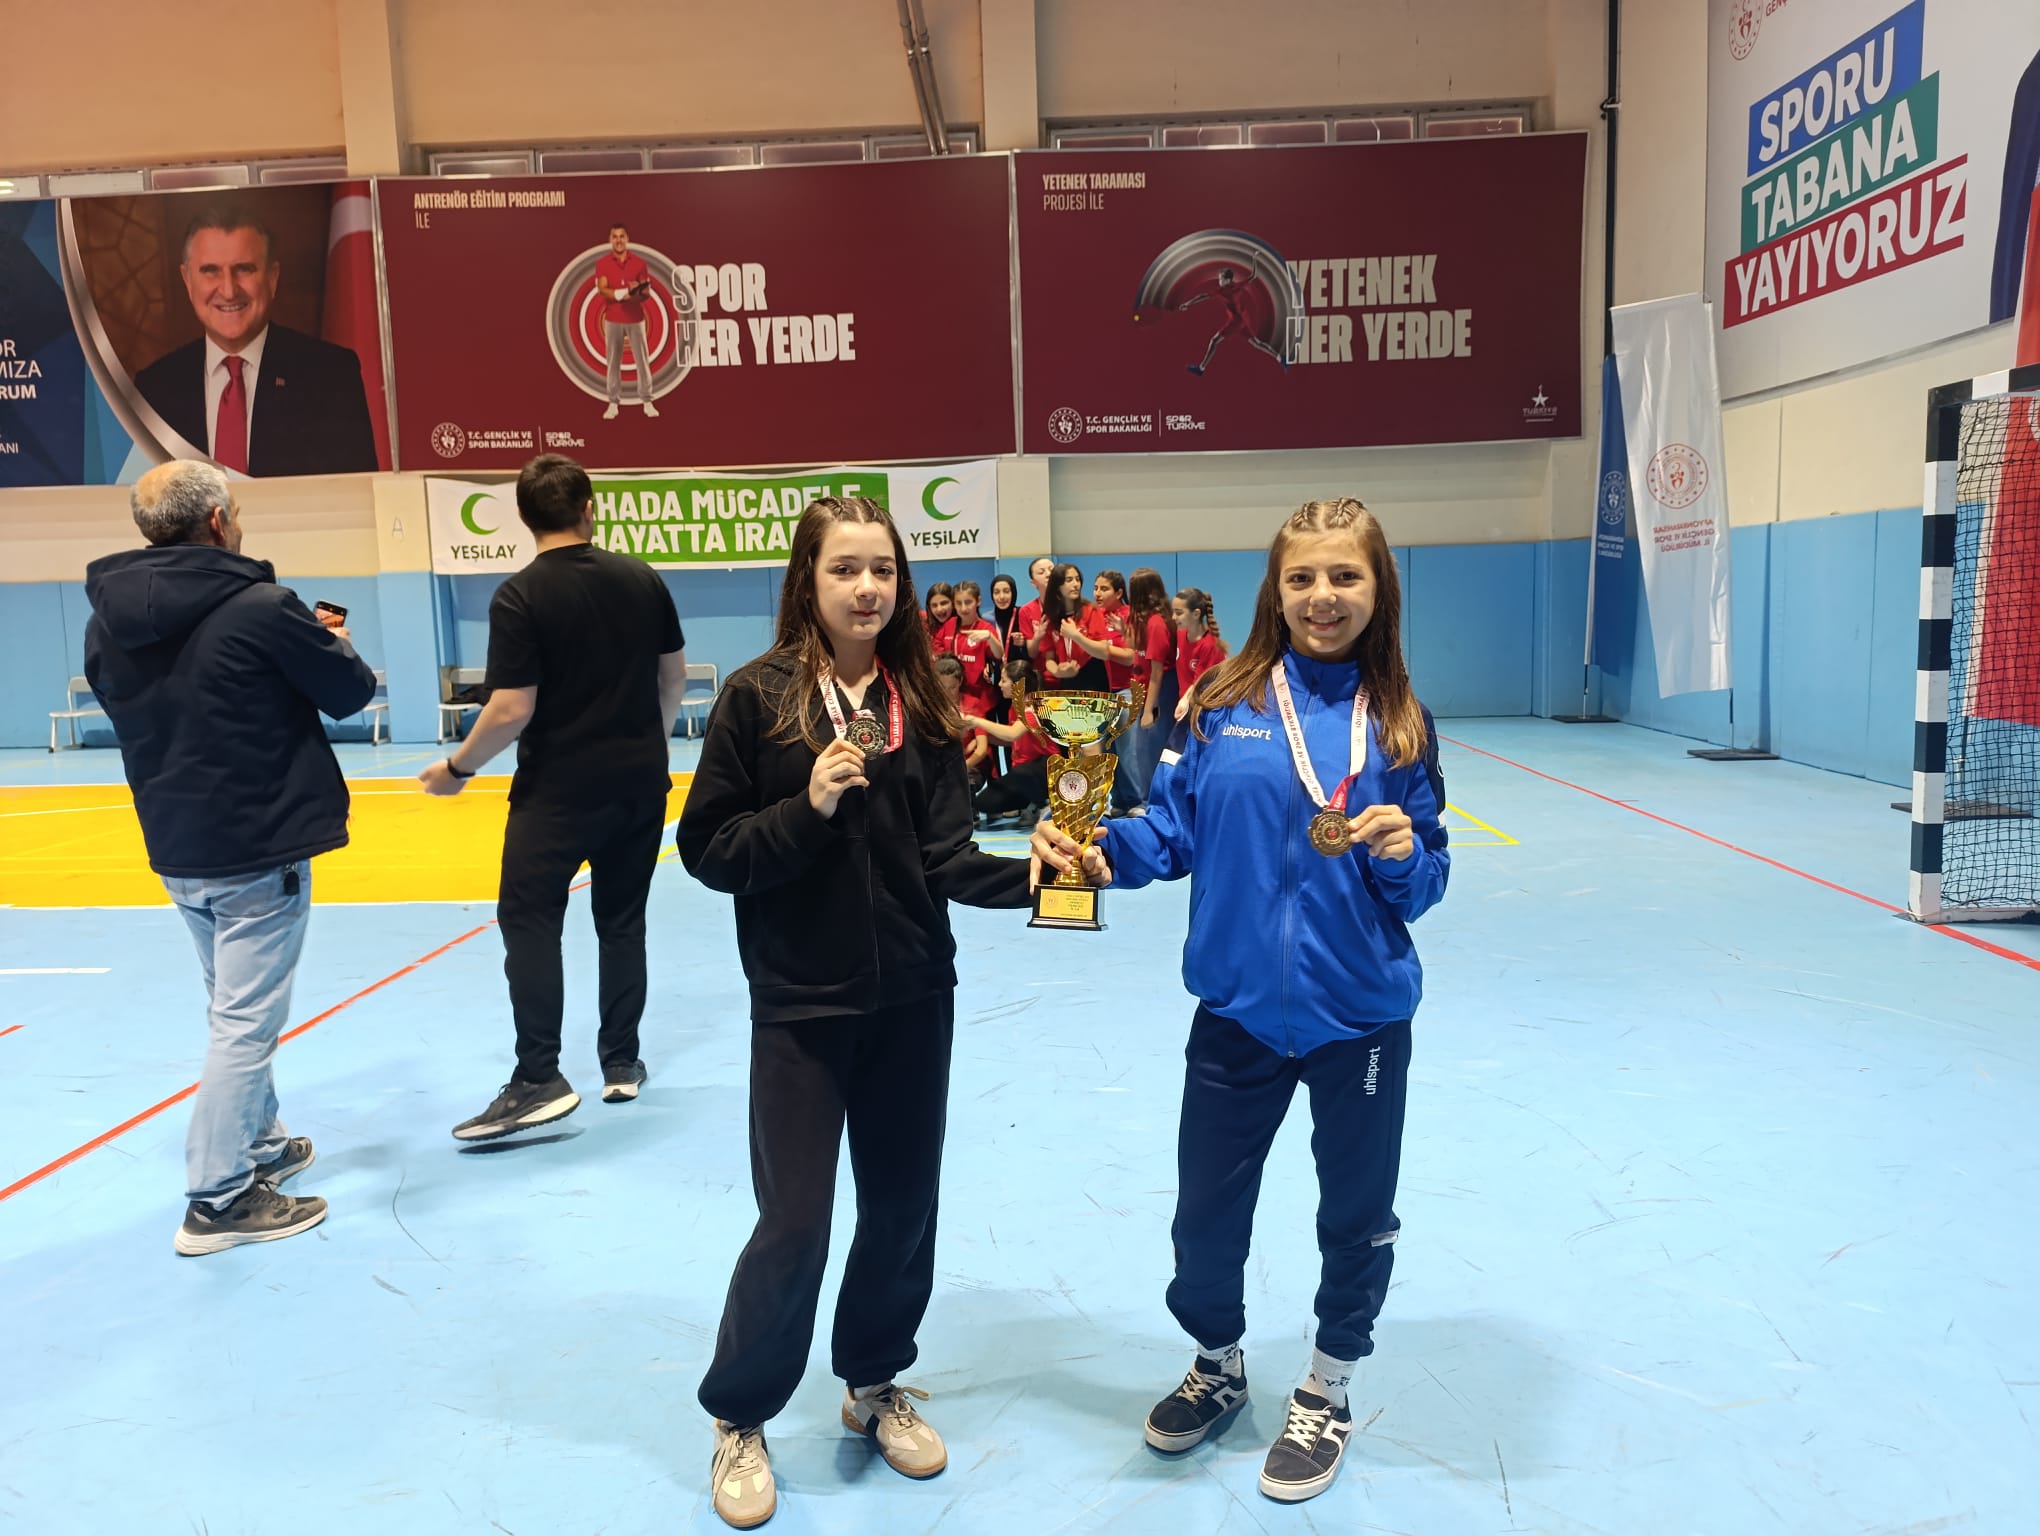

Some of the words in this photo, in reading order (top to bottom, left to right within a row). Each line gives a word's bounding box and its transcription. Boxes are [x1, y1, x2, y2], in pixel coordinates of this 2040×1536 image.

[1758, 27, 1895, 162] SPORU
[1752, 98, 1918, 243] TABANA
[1042, 174, 1087, 190] YETENEK
[1089, 172, 1146, 189] TARAMASI
[414, 190, 469, 209] ANTRENÖR
[470, 190, 506, 208] EĞİTİM
[508, 191, 565, 208] PROGRAMI
[1043, 192, 1086, 211] PROJESİ
[1089, 192, 1104, 210] İLE
[415, 211, 430, 229] İLE
[1735, 162, 1968, 317] YAYIYORUZ
[672, 263, 768, 314] SPOR
[1285, 254, 1438, 309] YETENEK
[674, 319, 742, 368] HER
[747, 312, 856, 365] YERDE
[1286, 314, 1353, 365] HER
[1362, 308, 1473, 362] YERDE
[1086, 416, 1100, 424] T.C.
[1102, 414, 1138, 426] GENÇLİK
[1140, 415, 1152, 423] VE
[1086, 425, 1107, 434] SPOR
[1109, 423, 1152, 433] BAKANLIĞI
[467, 431, 482, 440] T.C.
[484, 430, 519, 441] GENÇLİK
[521, 431, 532, 439] VE
[468, 440, 489, 449] SPOR
[491, 438, 533, 449] BAKANLIĞI
[592, 490, 684, 521] HADA
[591, 523, 727, 554] HAYATTA
[910, 529, 980, 549] YEŞİLAY
[451, 544, 517, 562] YEŞİLAY
[1222, 724, 1272, 740] uhlsport
[1363, 1045, 1381, 1095] uhlsport
